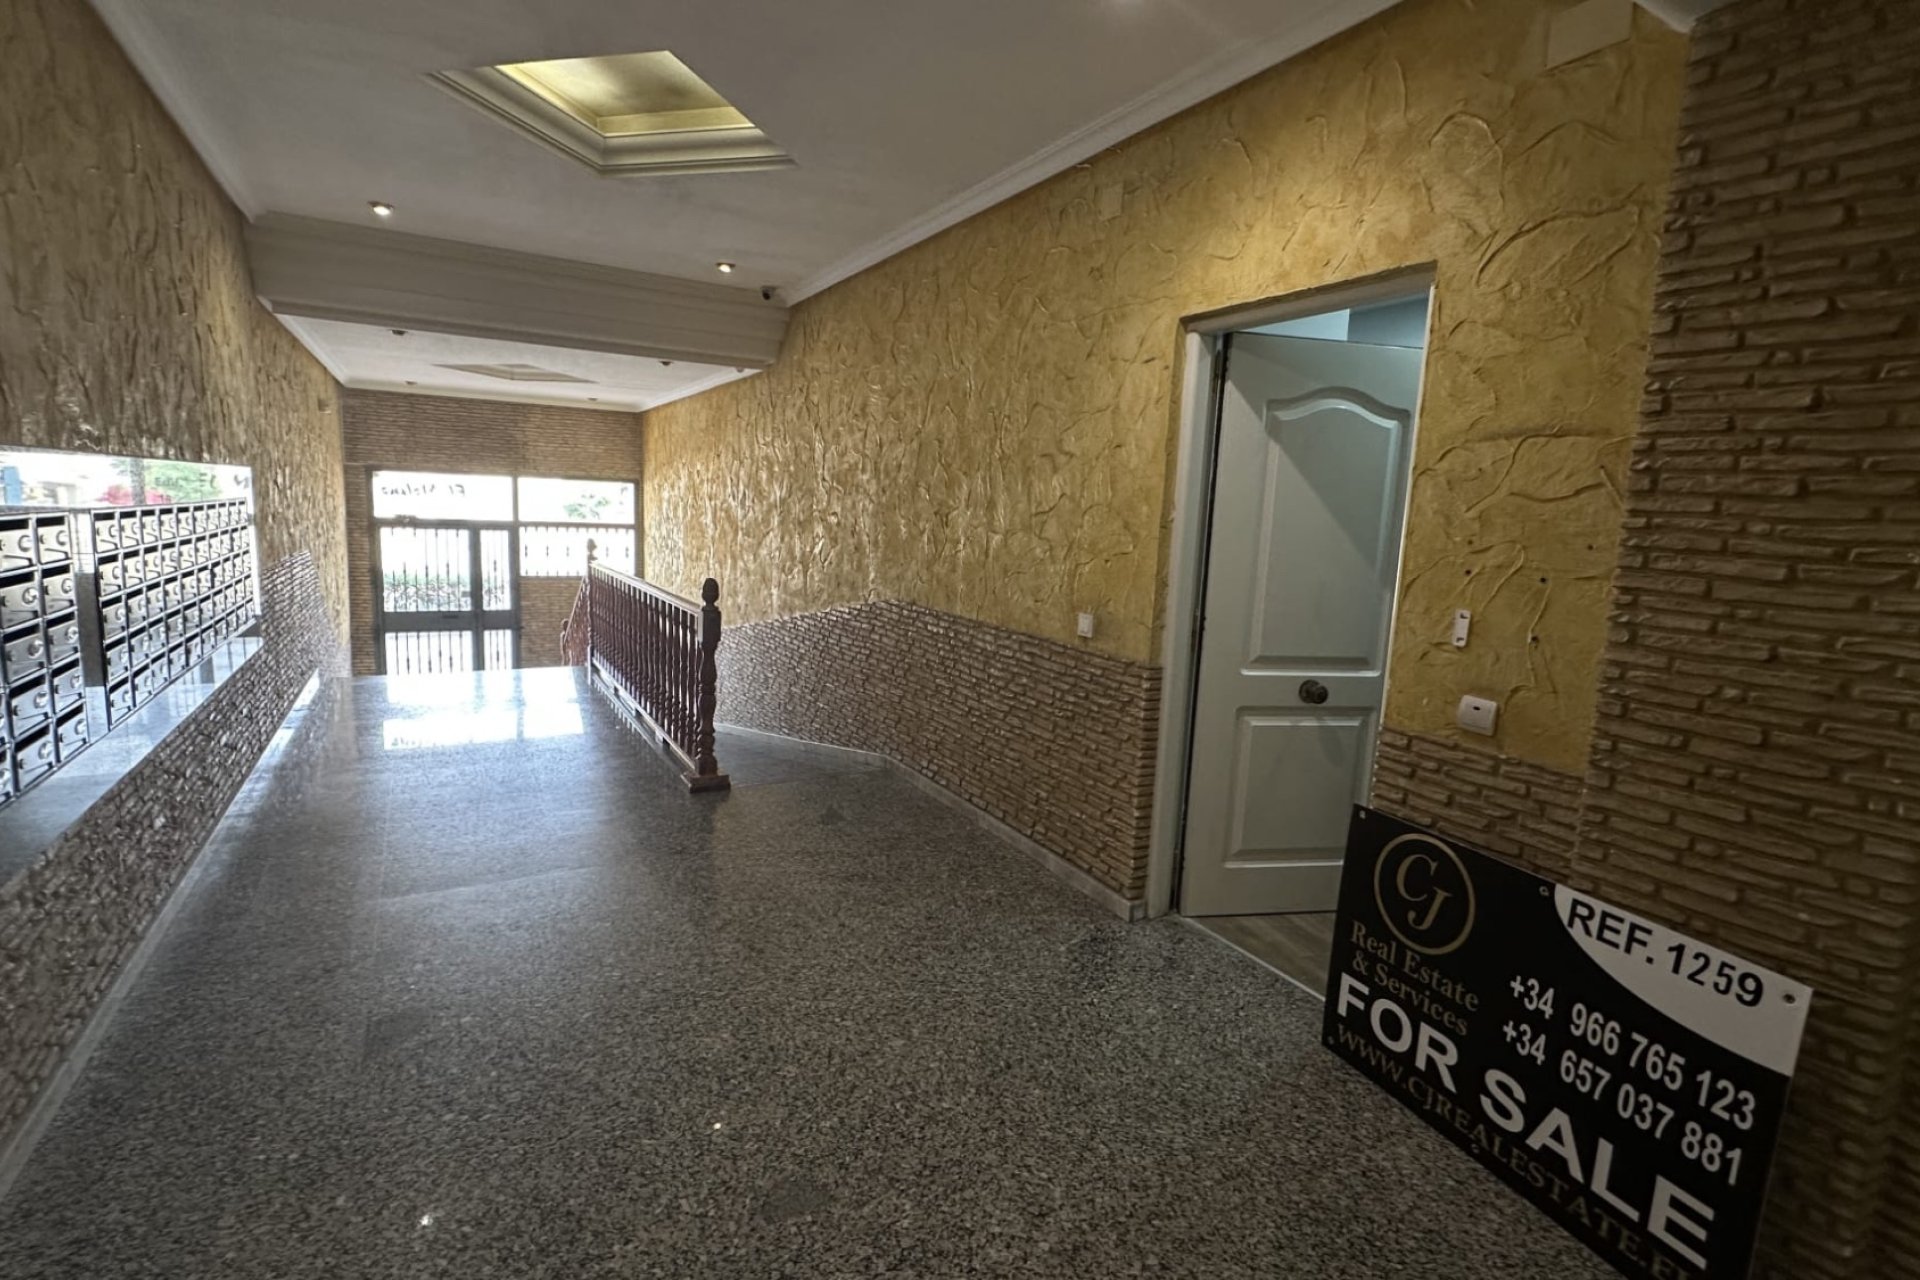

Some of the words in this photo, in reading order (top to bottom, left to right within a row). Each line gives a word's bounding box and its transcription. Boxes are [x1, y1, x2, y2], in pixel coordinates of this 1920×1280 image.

[1396, 853, 1453, 931] CJ
[1350, 920, 1397, 965] Real
[1403, 949, 1479, 1012] Estate
[1351, 949, 1369, 976] &
[1374, 962, 1468, 1037] Services
[1502, 1019, 1546, 1066] +34
[1560, 1049, 1612, 1101] 657
[1617, 1083, 1675, 1139] 037
[1681, 1121, 1742, 1187] 881
[1510, 975, 1554, 1020] +34
[1569, 1002, 1621, 1055] 966
[1629, 1031, 1685, 1091] 765
[1697, 1070, 1756, 1131] 123
[1338, 972, 1458, 1094] FOR
[1480, 1069, 1714, 1270] SALE
